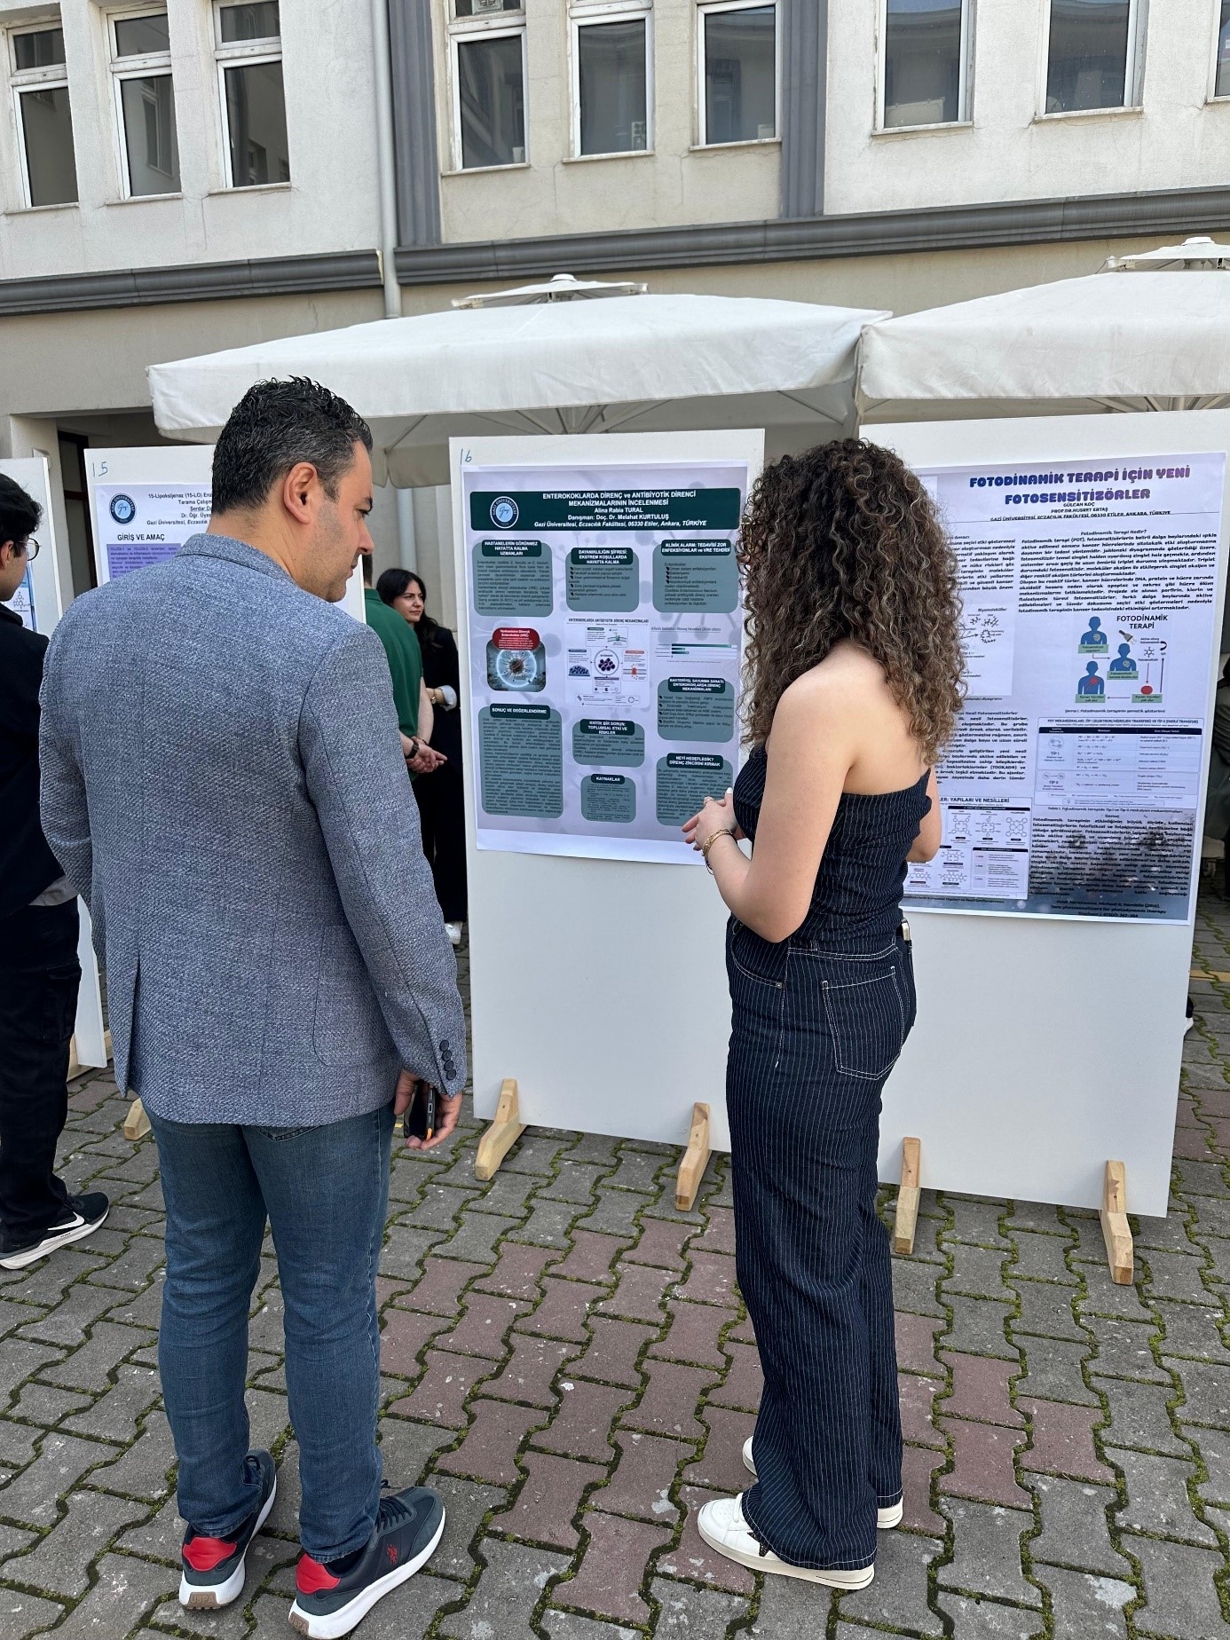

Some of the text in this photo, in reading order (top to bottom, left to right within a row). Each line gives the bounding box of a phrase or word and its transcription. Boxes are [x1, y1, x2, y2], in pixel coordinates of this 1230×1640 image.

[460, 449, 472, 465] 16
[92, 461, 108, 477] 15
[970, 465, 1190, 487] FOTODİNAMİK TERAPİ İÇİN YENİ
[1005, 488, 1150, 504] FOTOSENSİTİZÖRLER
